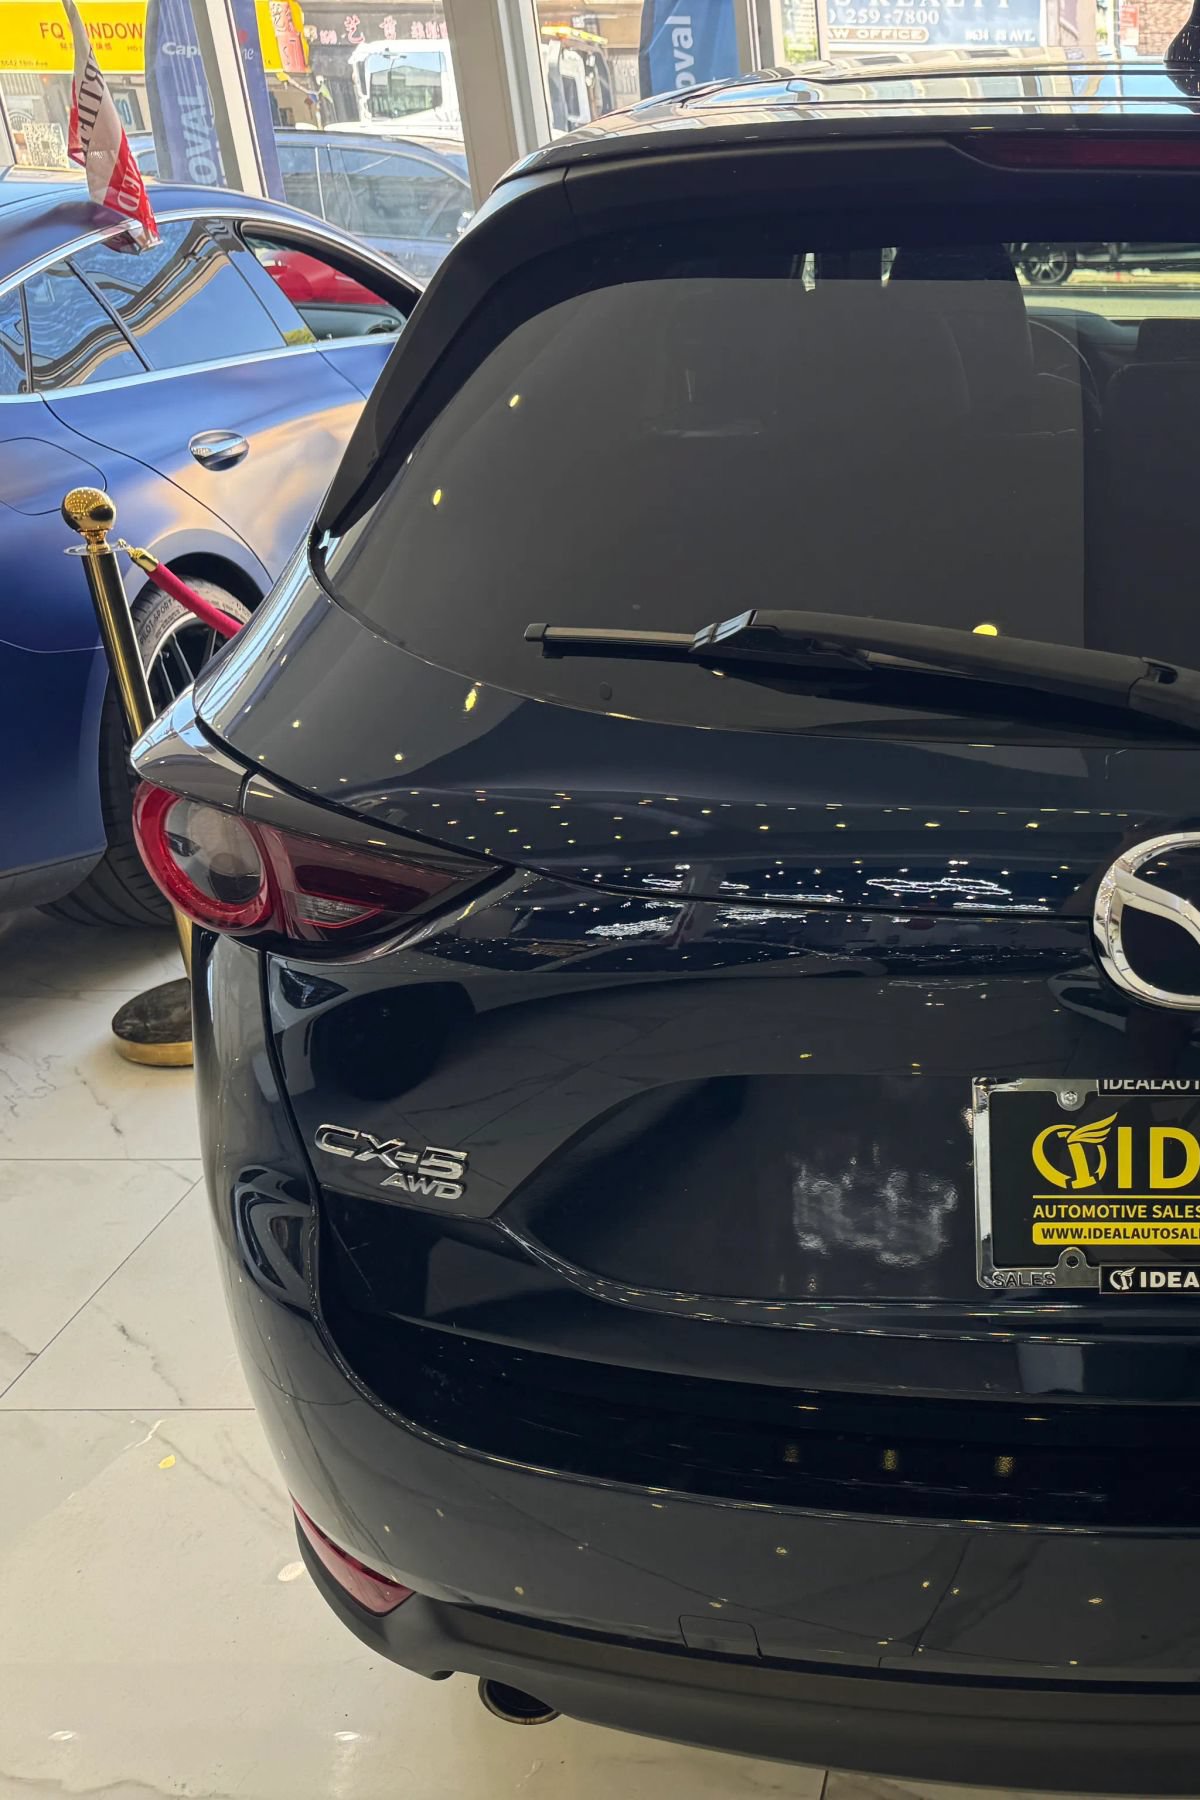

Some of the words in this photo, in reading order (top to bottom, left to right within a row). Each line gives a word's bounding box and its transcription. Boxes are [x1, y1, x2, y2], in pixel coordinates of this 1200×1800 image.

[40, 22, 65, 40] FQ
[71, 22, 143, 39] INDOW
[855, 28, 923, 40] OFFICE
[314, 1123, 468, 1180] CX-5
[379, 1172, 465, 1200] AWD
[1033, 1204, 1148, 1219] AUTOMOTIVE
[992, 1271, 1056, 1288] SALES
